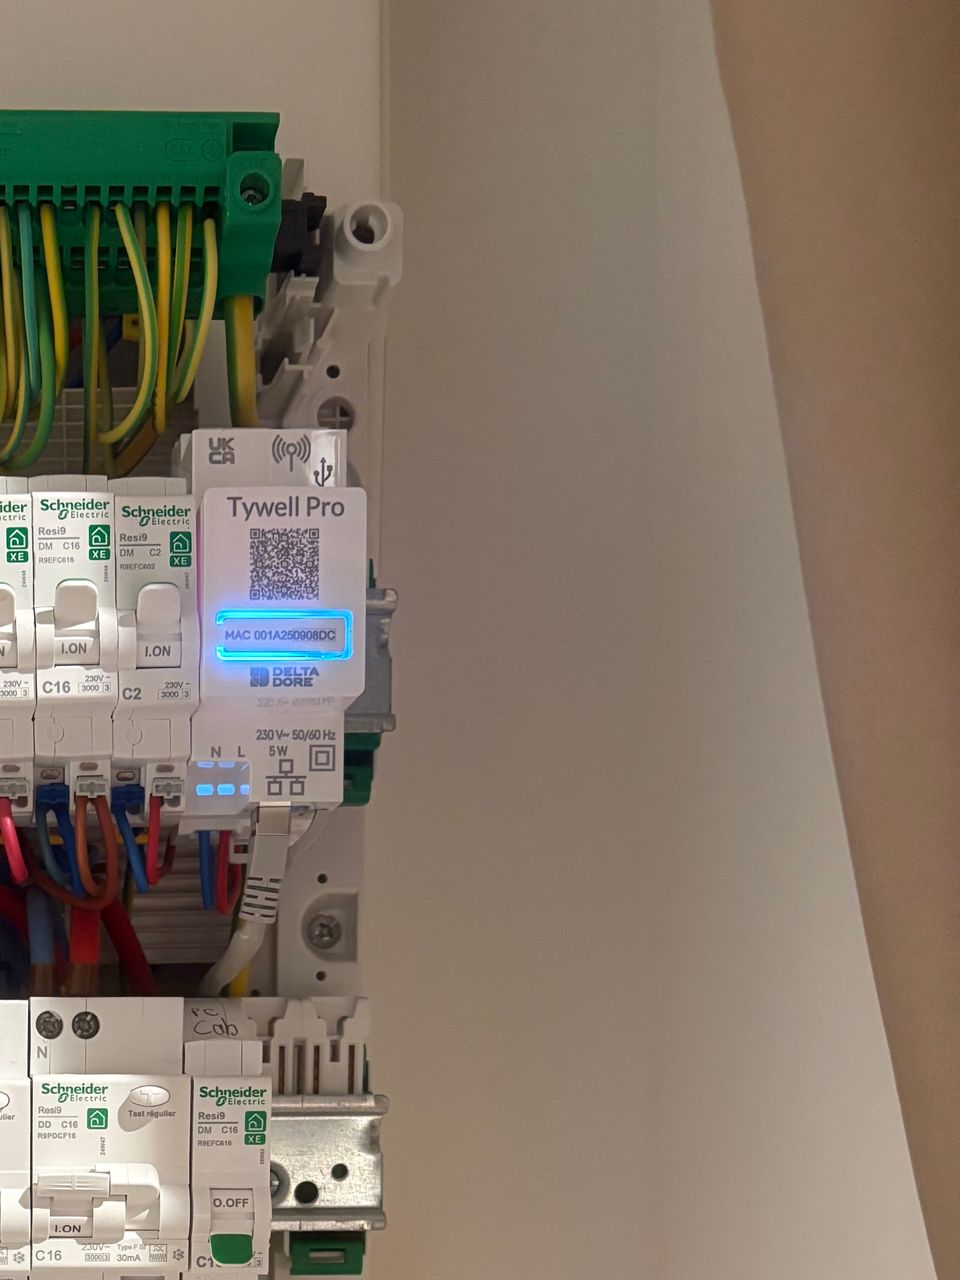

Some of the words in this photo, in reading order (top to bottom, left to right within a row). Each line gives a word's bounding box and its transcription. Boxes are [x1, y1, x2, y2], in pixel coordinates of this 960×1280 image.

[40, 499, 110, 511] Schneider
[227, 496, 299, 521] Tywell
[306, 497, 345, 517] Pro
[70, 511, 109, 519] Electric
[121, 506, 191, 518] Schneider
[38, 527, 66, 536] Resi9
[92, 550, 106, 558] XE
[225, 630, 251, 640] MAC
[61, 643, 87, 654] I.ON
[144, 646, 171, 657] I.ON
[272, 667, 319, 676] DELTA
[42, 681, 71, 694] C16
[272, 677, 313, 687] DORE
[122, 688, 142, 700] C2
[256, 730, 274, 740] 230
[292, 730, 321, 741] 50/60
[323, 730, 336, 740] Hz
[211, 747, 221, 757] N
[237, 747, 245, 757] L
[37, 1045, 47, 1059] N
[41, 1083, 108, 1095] Schneider
[199, 1087, 267, 1098] Schneider
[198, 1112, 225, 1120] Resi9
[248, 1135, 262, 1143] XE
[213, 1198, 249, 1208] O.OFF
[54, 1225, 81, 1233] I.ON
[35, 1250, 62, 1262] C16
[196, 1256, 222, 1268] C1
